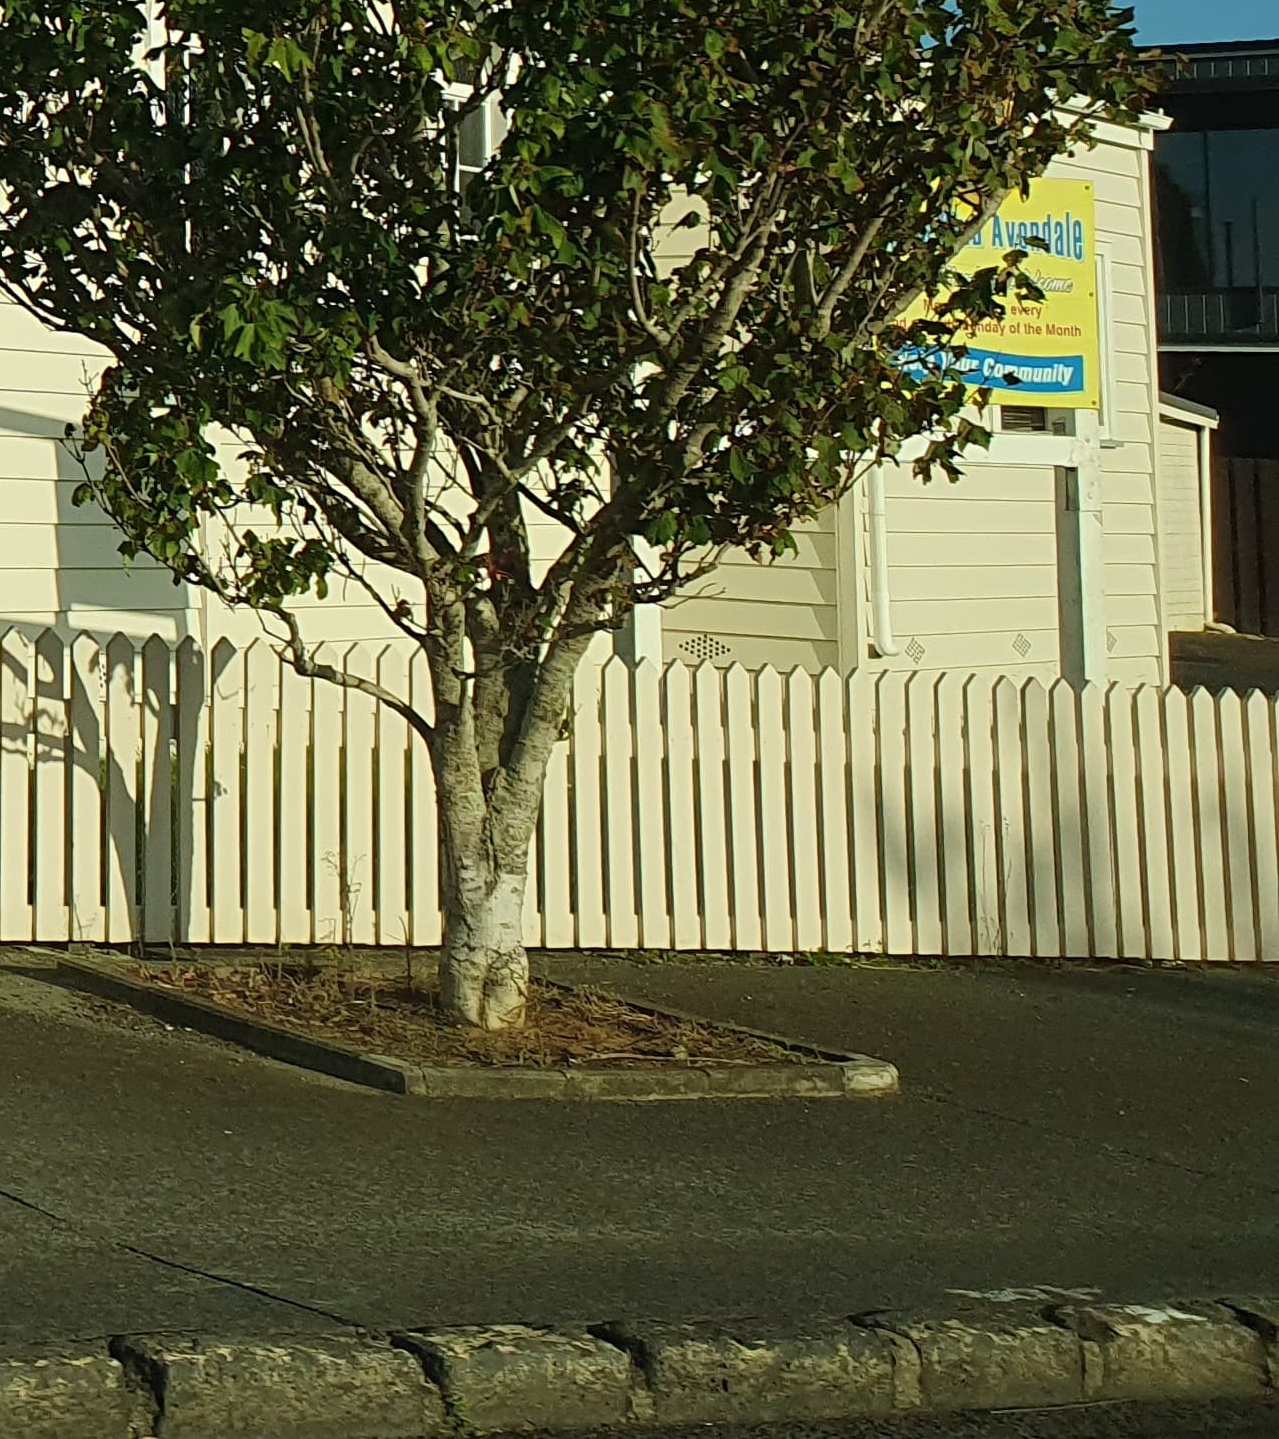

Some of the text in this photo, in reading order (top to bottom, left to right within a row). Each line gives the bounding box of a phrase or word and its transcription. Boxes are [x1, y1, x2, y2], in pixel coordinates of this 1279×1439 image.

[992, 212, 1083, 260] Avondale
[1010, 305, 1042, 319] every
[1009, 322, 1020, 334] of
[1024, 323, 1042, 335] the
[1046, 323, 1082, 337] Month
[983, 357, 1074, 386] Community
